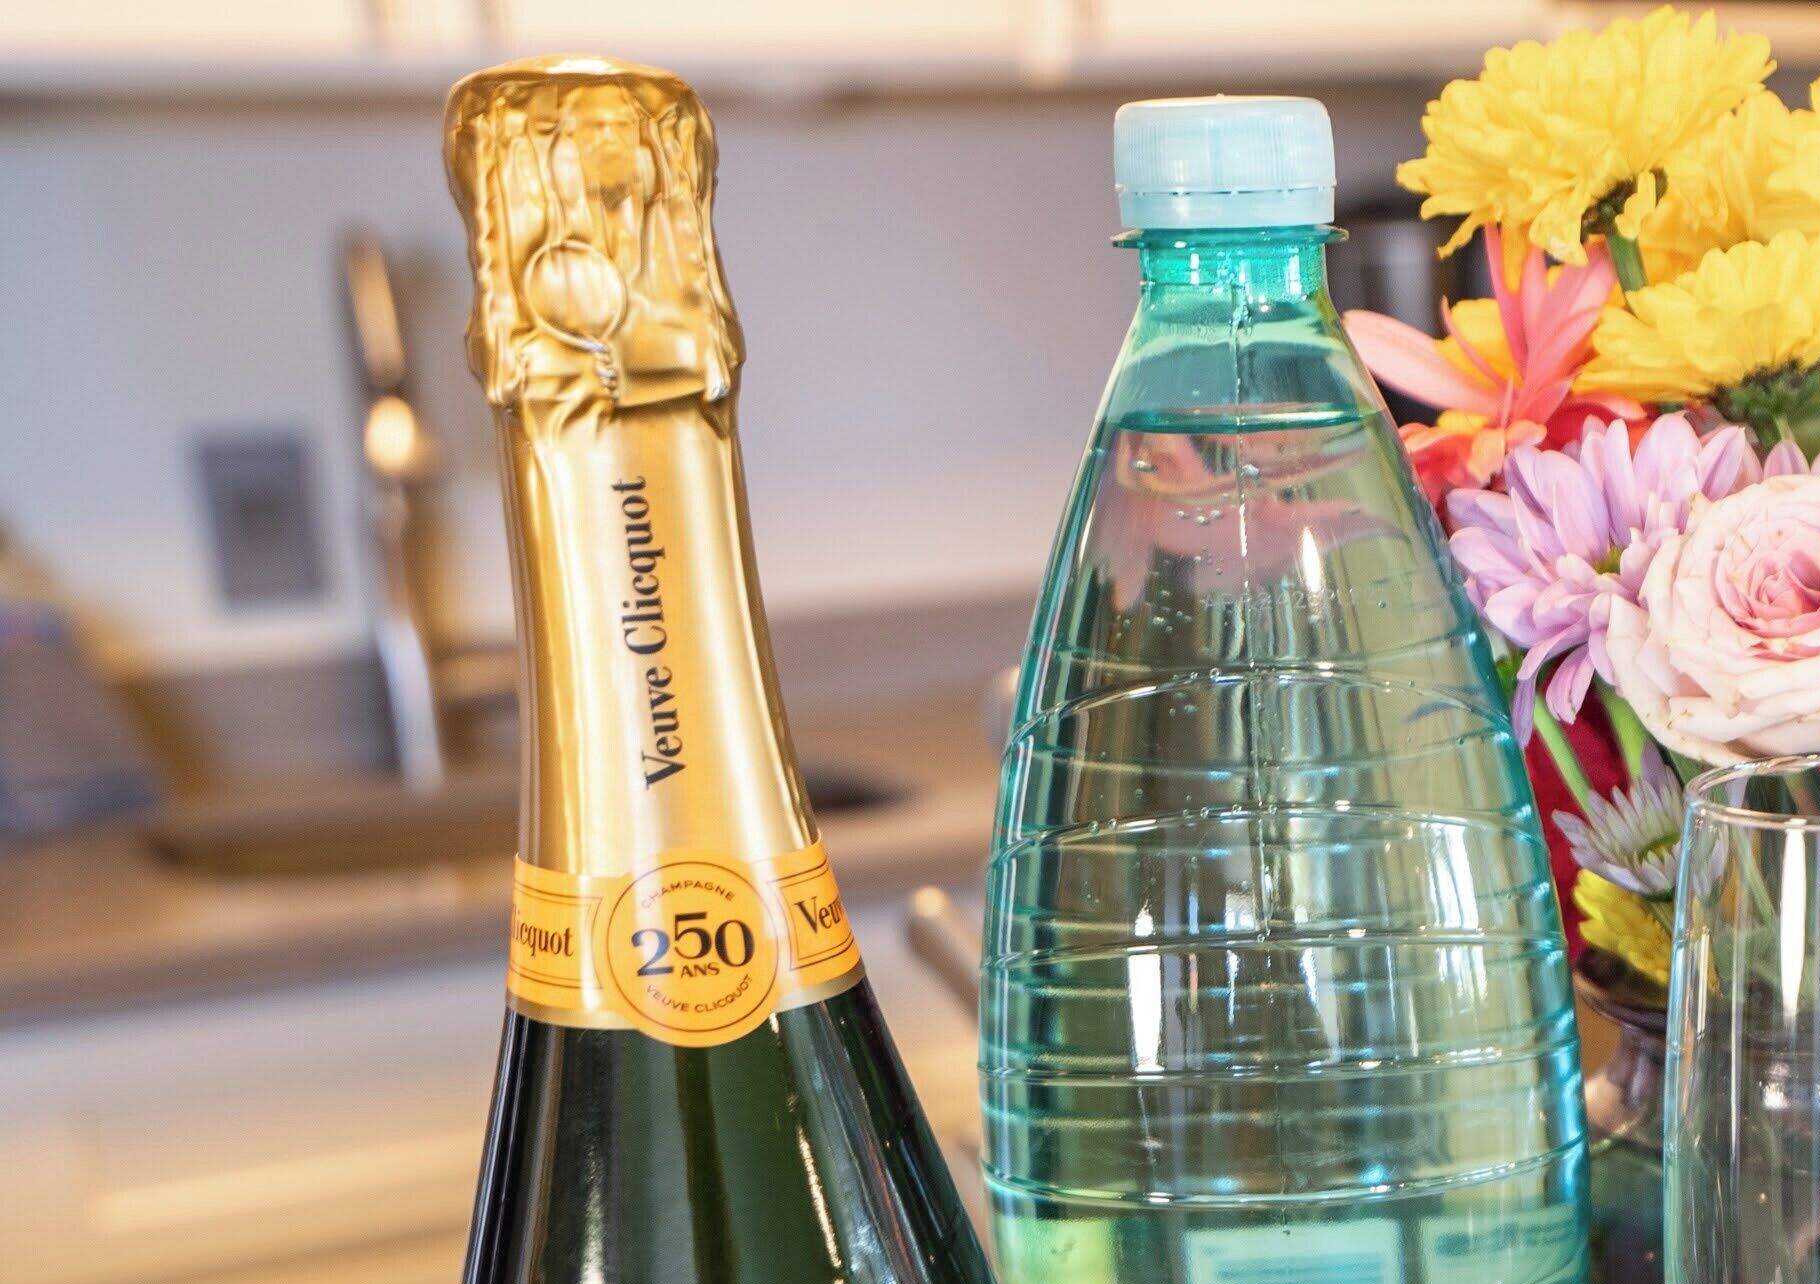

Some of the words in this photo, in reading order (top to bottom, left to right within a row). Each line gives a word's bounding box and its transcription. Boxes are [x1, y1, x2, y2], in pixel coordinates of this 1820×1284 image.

[611, 475, 667, 655] Clicquot
[642, 665, 686, 790] Veuve
[641, 879, 735, 911] CHAMPAGNE
[631, 911, 755, 977] 250
[679, 961, 721, 979] ANS
[646, 984, 689, 1013] VEUVE
[693, 973, 753, 1014] CLICQUOT
